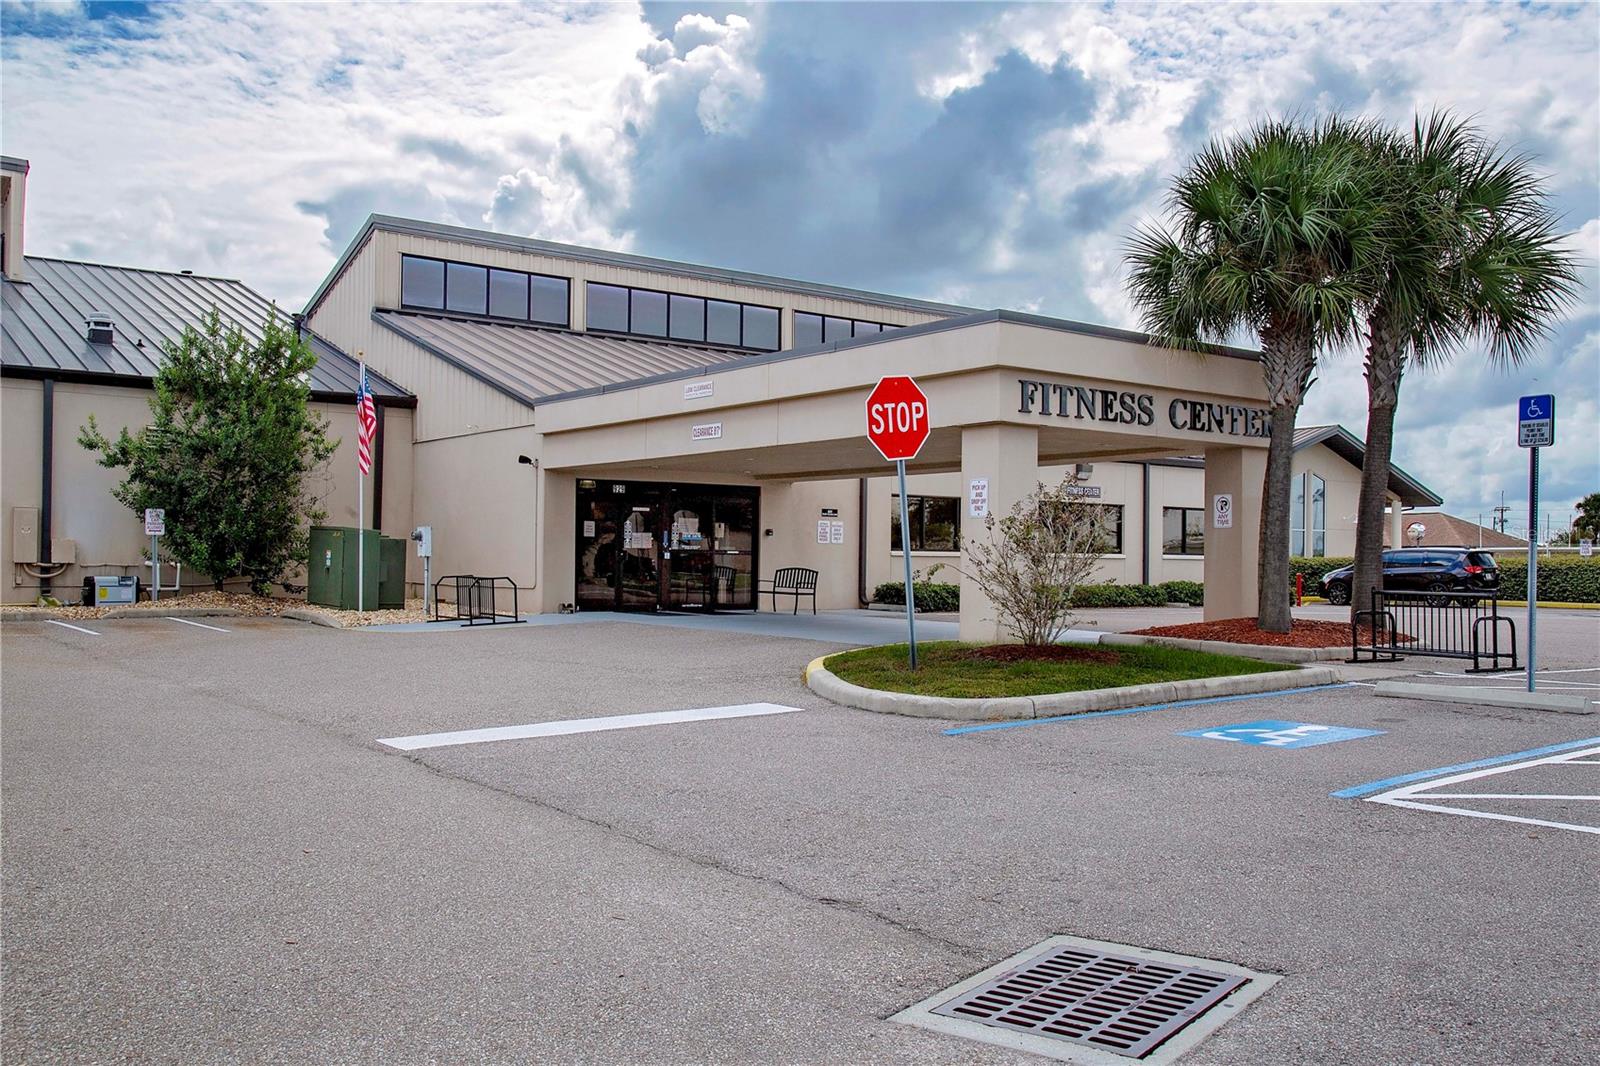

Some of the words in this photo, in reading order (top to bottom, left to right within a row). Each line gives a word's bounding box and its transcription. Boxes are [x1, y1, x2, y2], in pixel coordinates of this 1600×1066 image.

[871, 401, 925, 435] STOP
[1018, 379, 1155, 427] FITNESS
[693, 426, 713, 438] CLEARANCE
